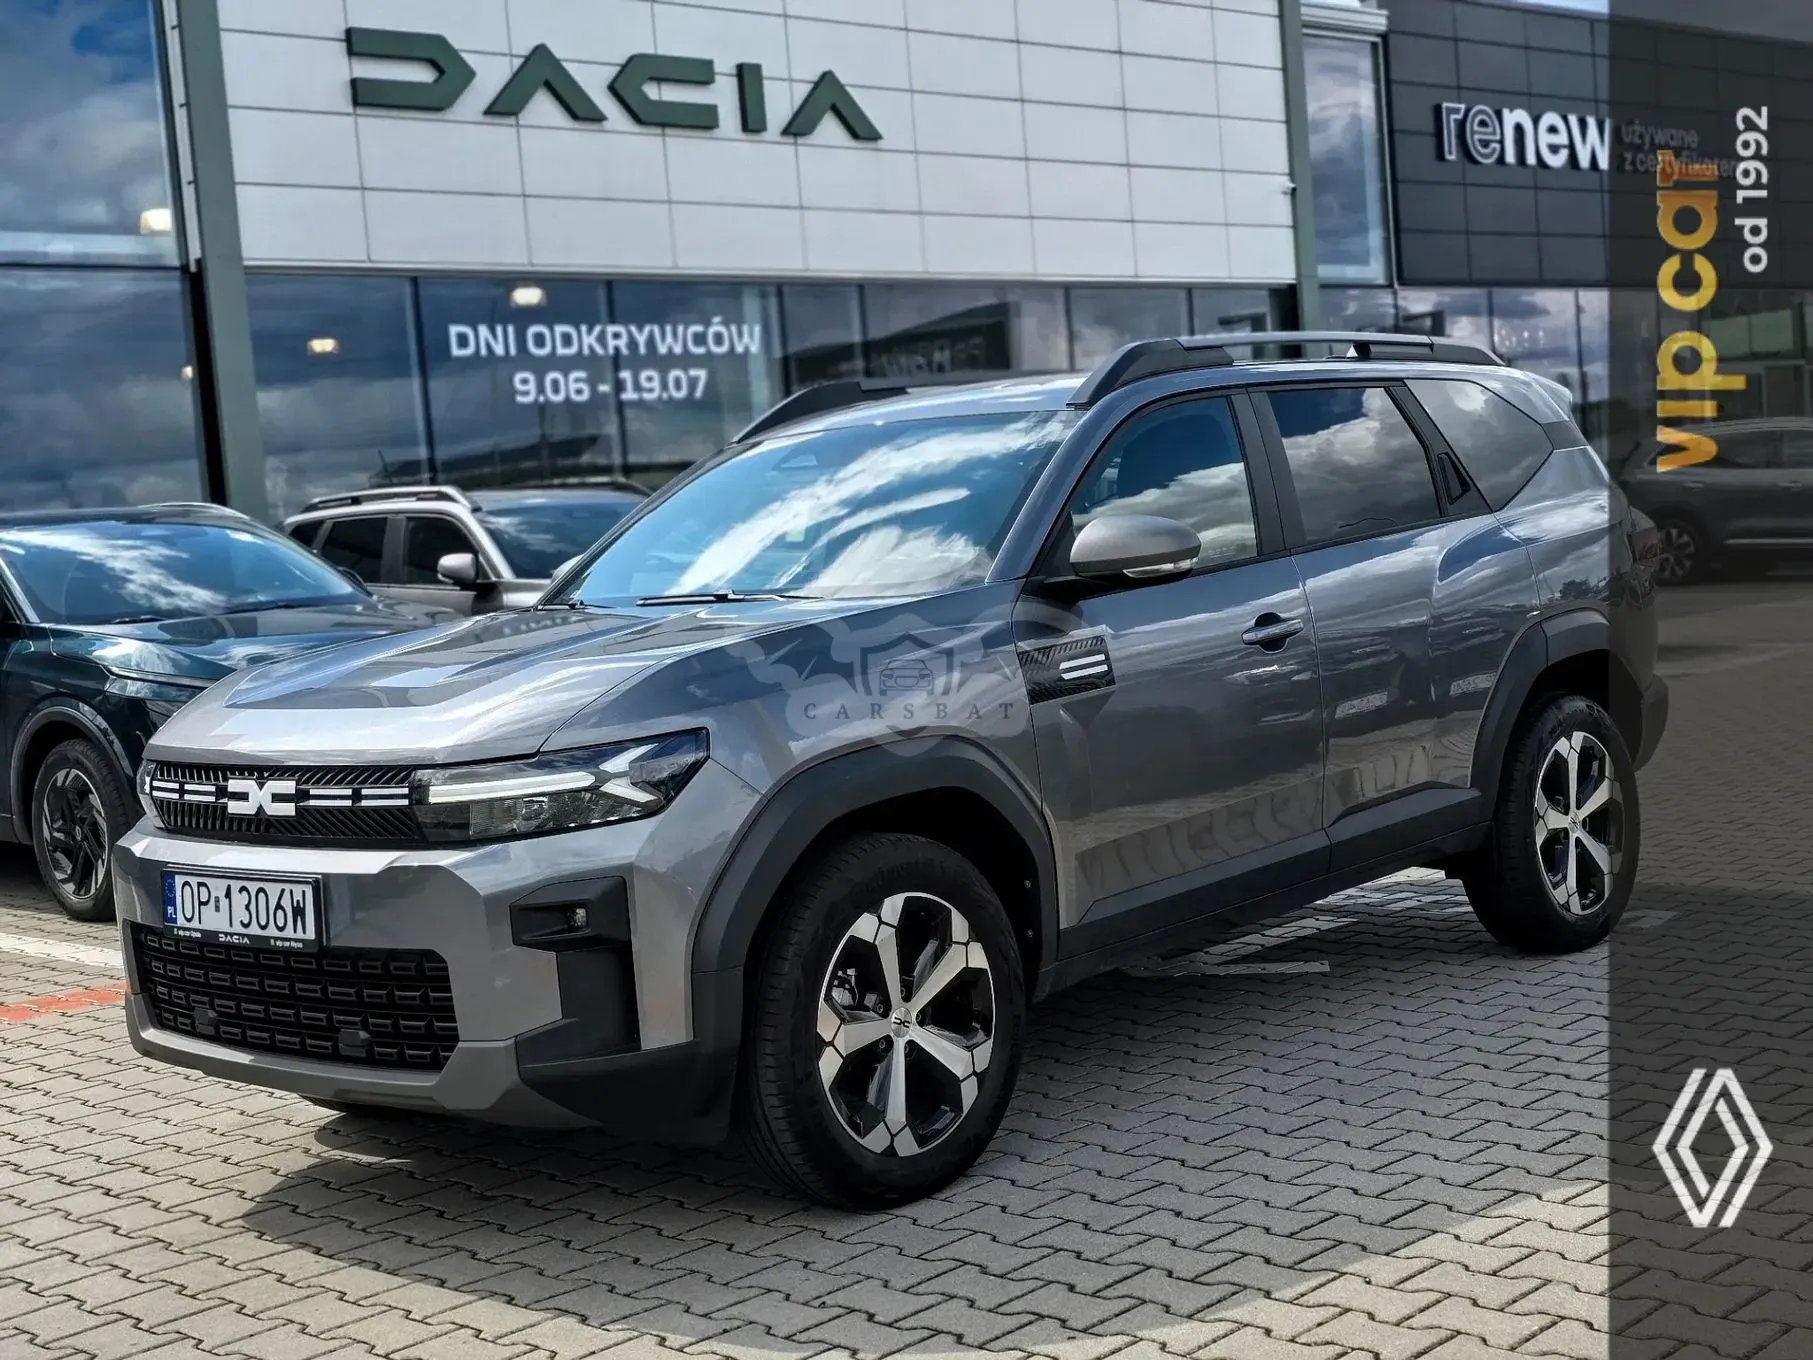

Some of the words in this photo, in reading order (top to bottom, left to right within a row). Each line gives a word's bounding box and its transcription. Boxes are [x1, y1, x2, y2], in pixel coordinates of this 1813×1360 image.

[346, 27, 883, 140] DACIA
[1441, 101, 1610, 171] renew
[1620, 120, 1698, 150] używane
[1624, 152, 1633, 171] z
[448, 324, 518, 357] DNI
[525, 316, 762, 356] ODKRYWCÓW
[513, 369, 591, 404] 9.06
[618, 367, 709, 401] 19.07
[167, 906, 177, 918] PL
[181, 880, 211, 924] OP
[224, 884, 306, 935] 1306W
[218, 934, 250, 945] DACIA
